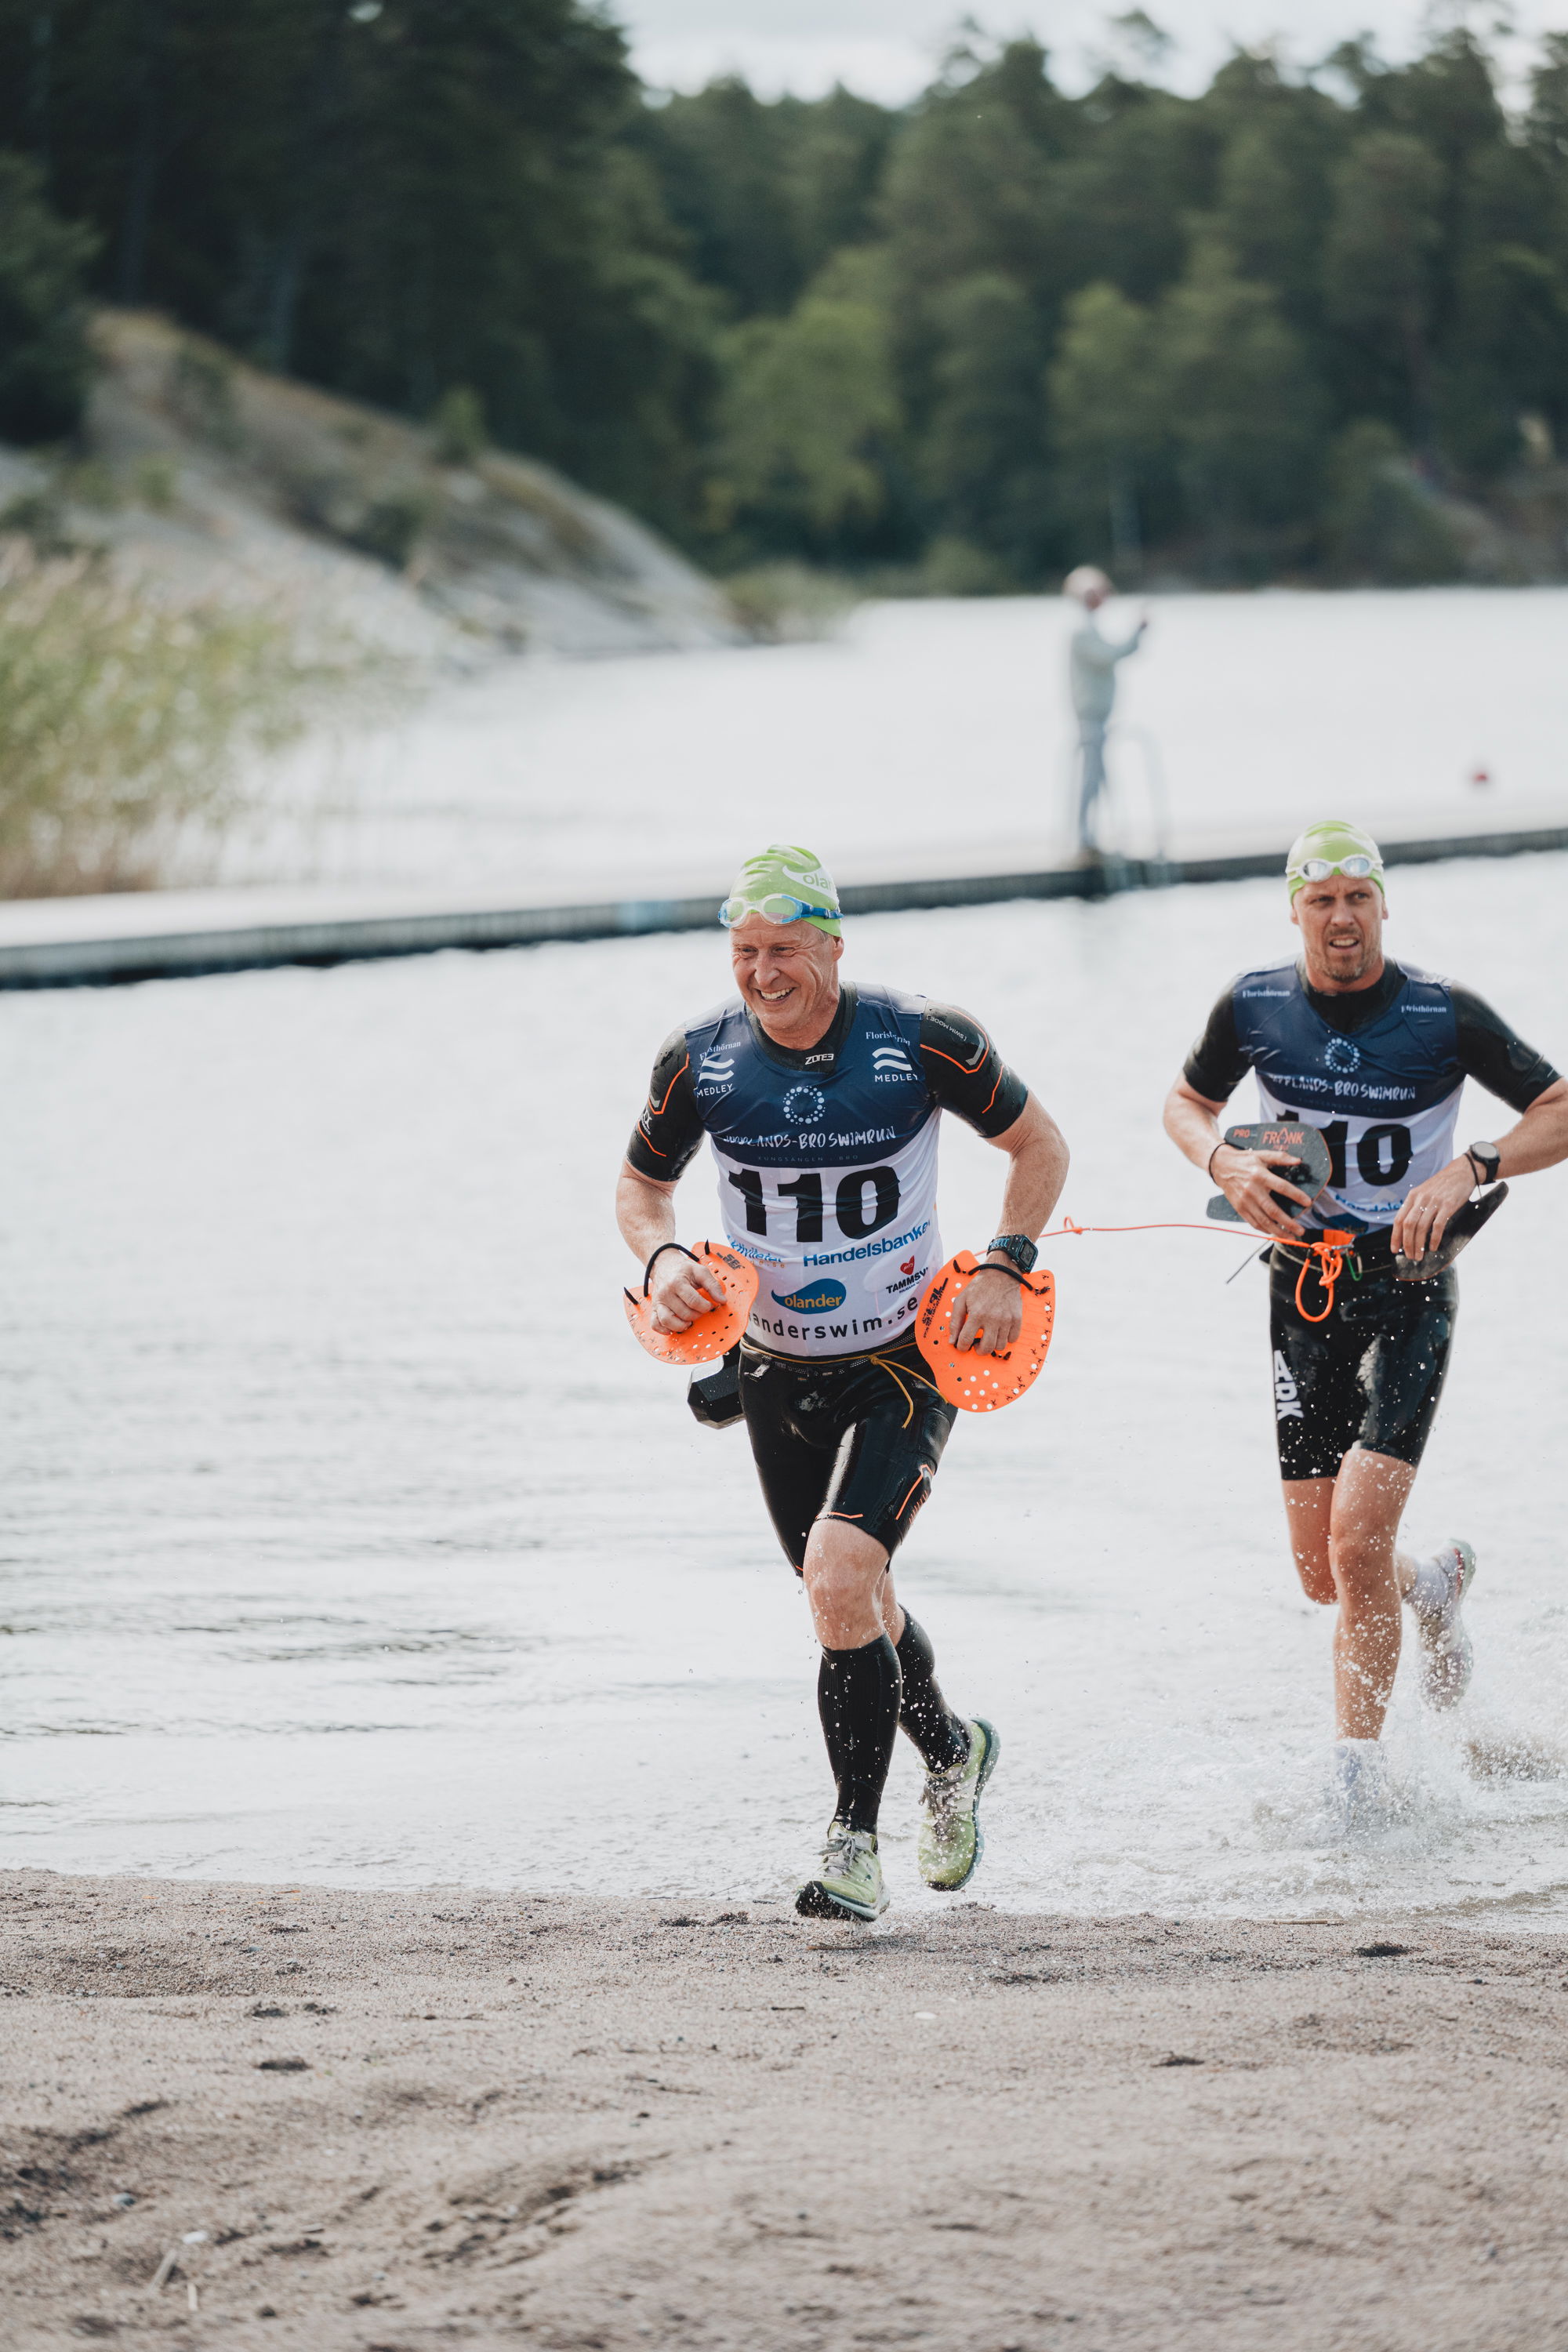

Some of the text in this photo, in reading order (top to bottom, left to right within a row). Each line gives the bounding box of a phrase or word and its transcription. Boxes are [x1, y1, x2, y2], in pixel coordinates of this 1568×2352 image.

[696, 1083, 733, 1098] MEDLEY
[828, 1126, 897, 1147] SWIMRUN
[1232, 1129, 1250, 1138] PRO
[1276, 1109, 1414, 1189] 10
[728, 1166, 901, 1242] 110
[803, 1219, 931, 1267] Handelsbanke
[886, 1266, 928, 1294] TAMMSV
[784, 1294, 843, 1308] olander
